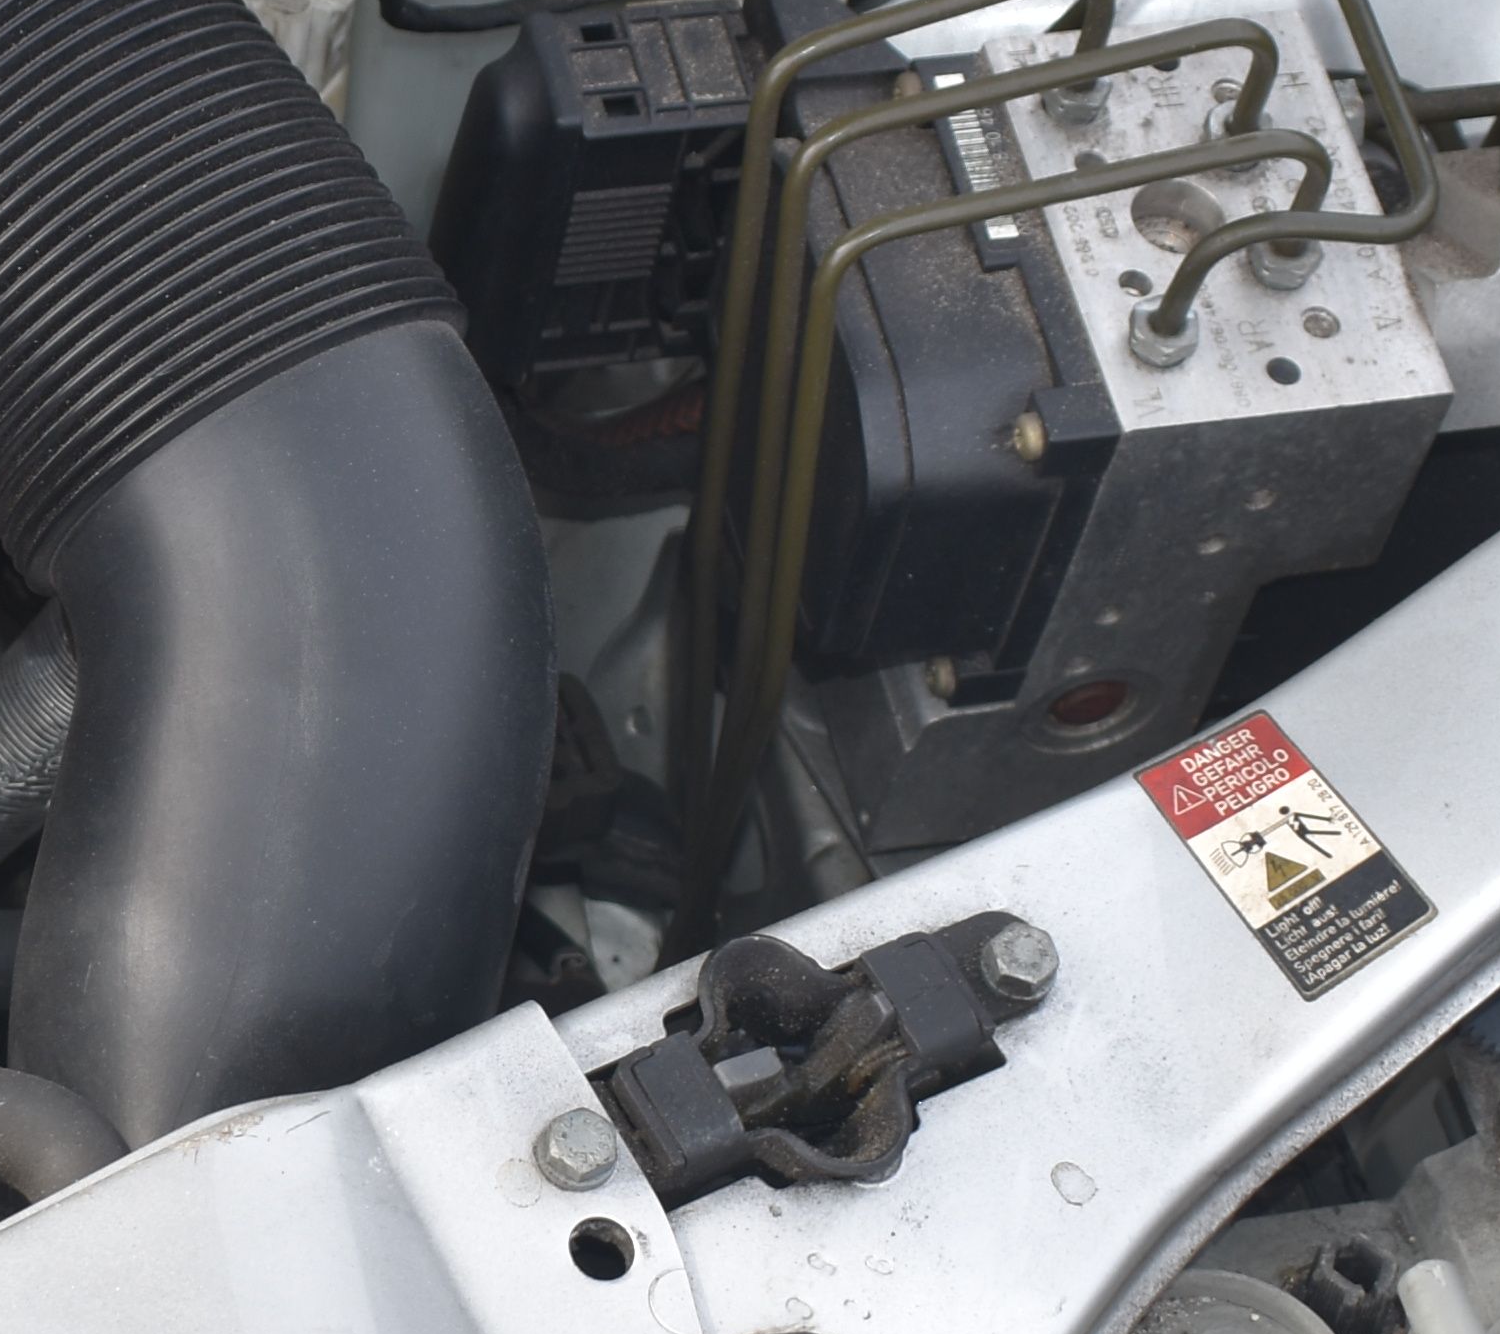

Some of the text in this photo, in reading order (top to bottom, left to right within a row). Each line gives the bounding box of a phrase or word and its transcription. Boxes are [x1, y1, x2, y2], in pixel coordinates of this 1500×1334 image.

[1180, 728, 1256, 773] DANGER
[1191, 743, 1264, 787] GEFAHR
[1202, 748, 1290, 802] PERICOLO
[1214, 767, 1291, 816] PELIGRO
[1307, 778, 1322, 791] 20
[1264, 911, 1300, 938] Light
[1335, 916, 1350, 929] la
[1348, 879, 1401, 920] lumière!
[1274, 904, 1339, 950] Licht aus!
[1293, 932, 1354, 974] Spegnere
[1358, 908, 1386, 931] fari!
[1351, 941, 1367, 954] la
[1364, 922, 1391, 945] luz!
